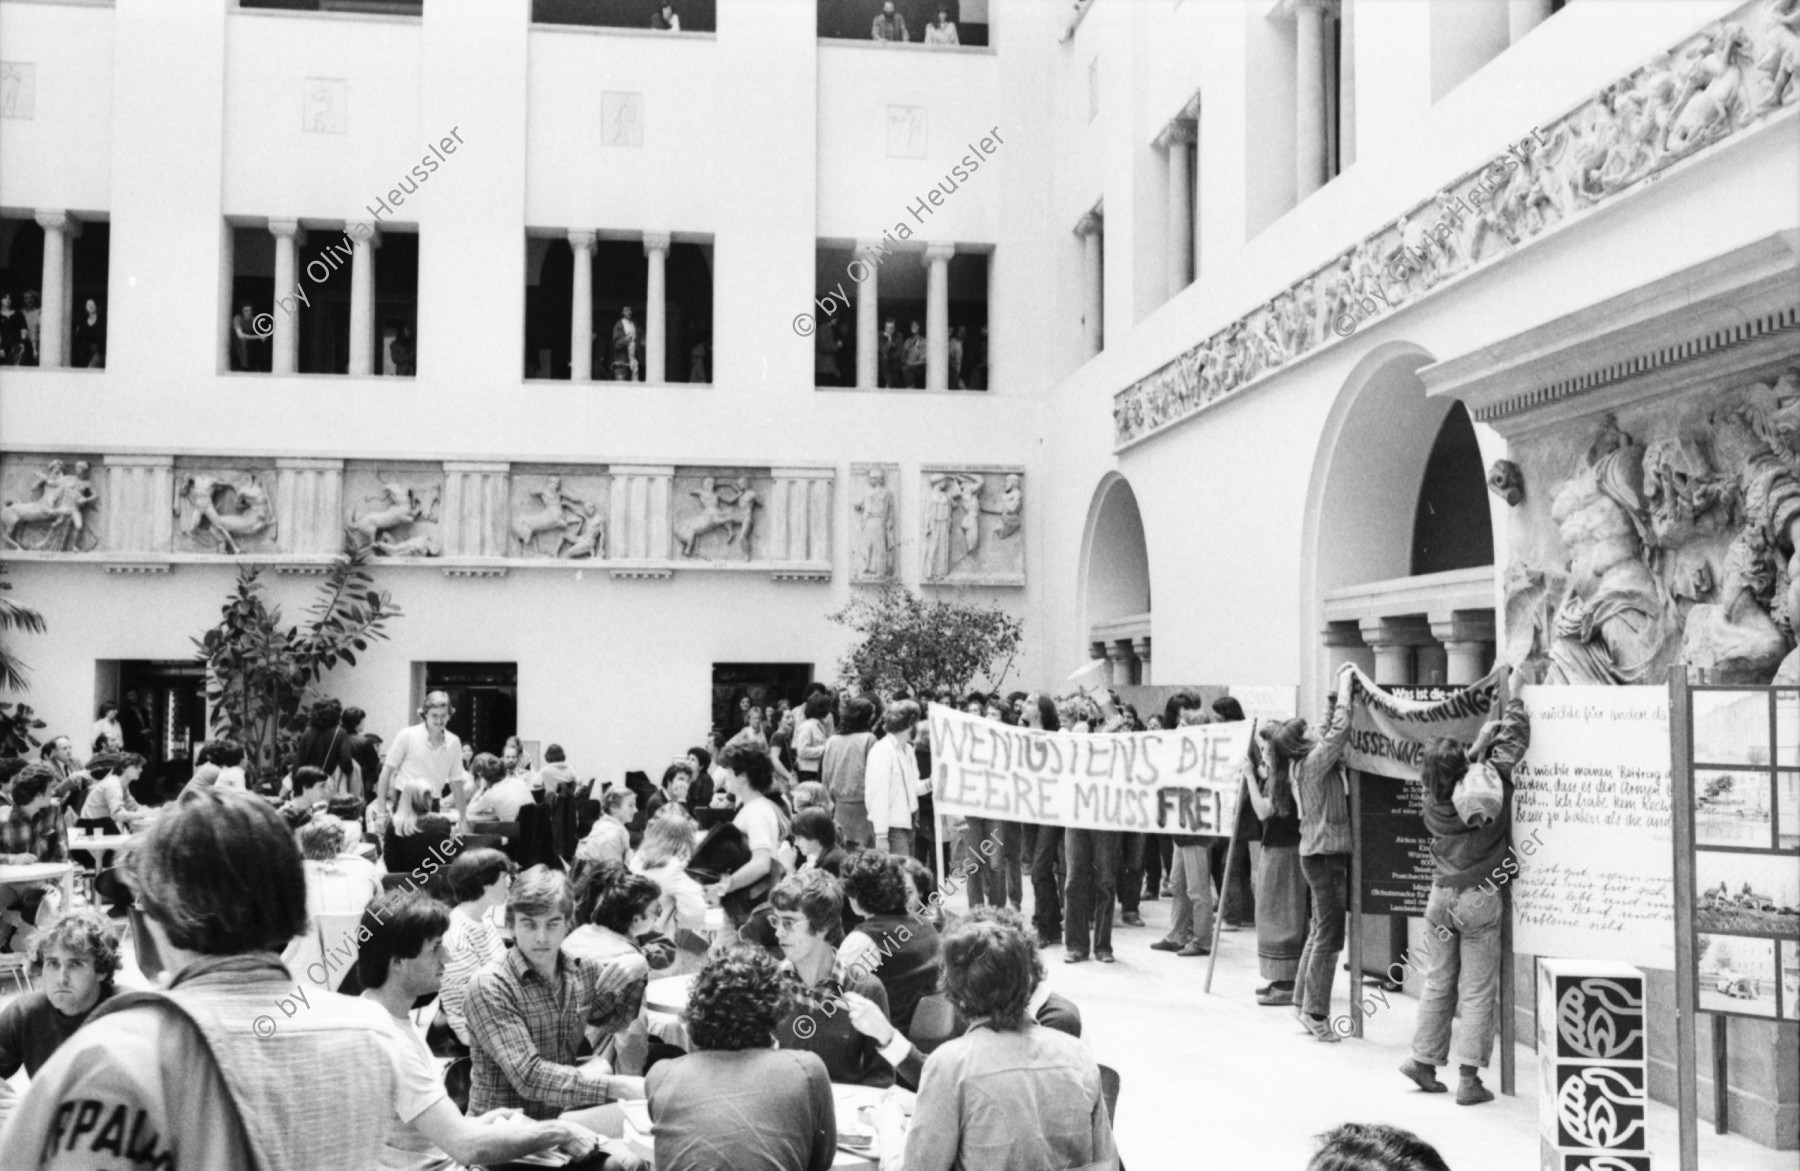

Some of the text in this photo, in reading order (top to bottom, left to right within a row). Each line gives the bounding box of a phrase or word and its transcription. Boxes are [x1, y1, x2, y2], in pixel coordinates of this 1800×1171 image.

[1416, 687, 1428, 700] ist
[1430, 687, 1446, 700] die
[931, 716, 1232, 786] WENIGSTENS DIE
[1534, 762, 1570, 777] möchte
[1574, 765, 1613, 779] meinen
[1618, 765, 1662, 787] Beitrag
[1581, 781, 1592, 793] es
[1595, 778, 1616, 793] den
[934, 763, 1222, 833] LEERE MUSS FREI
[1575, 792, 1608, 809] habe
[1564, 810, 1600, 825] haben
[1604, 810, 1621, 826] als
[1625, 813, 1642, 827] die
[1519, 911, 1579, 927] Probleme
